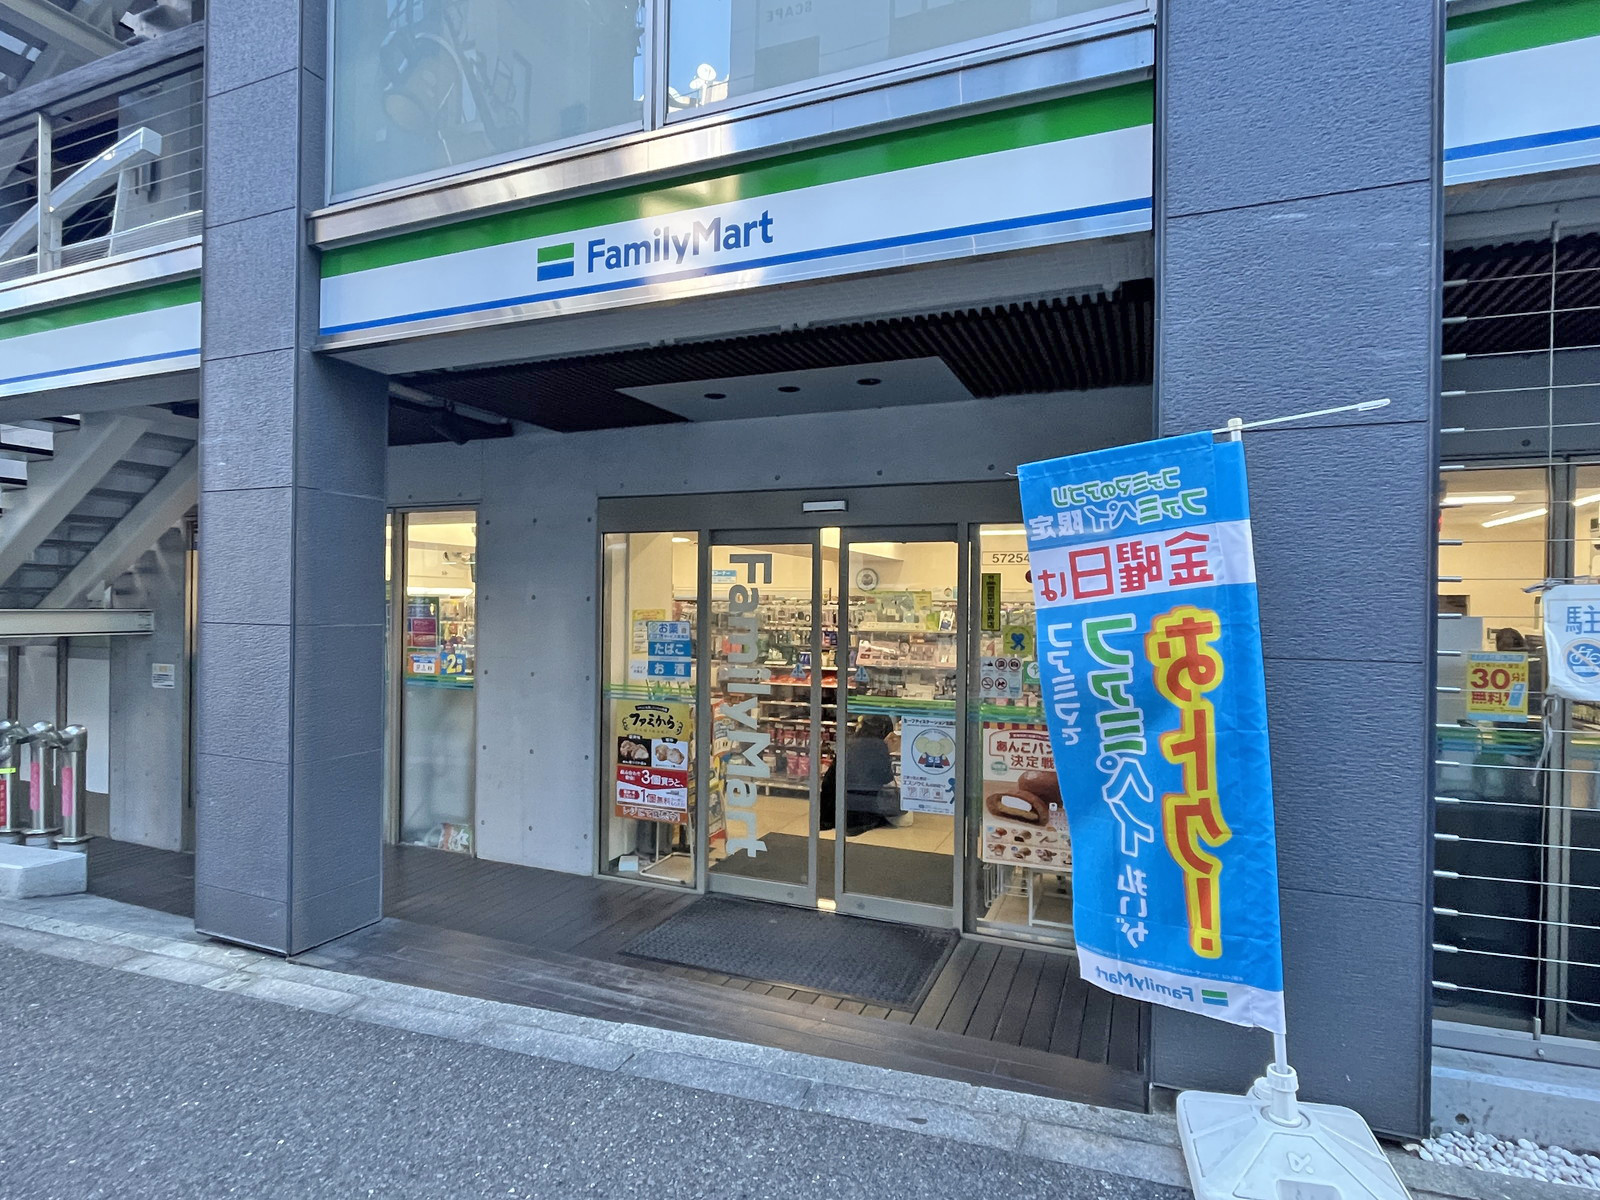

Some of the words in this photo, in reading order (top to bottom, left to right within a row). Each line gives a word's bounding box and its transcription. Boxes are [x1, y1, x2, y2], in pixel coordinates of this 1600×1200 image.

[587, 209, 774, 273] FamilyMart
[654, 642, 685, 655] たばこ
[720, 553, 773, 858] FamilyMart
[629, 712, 676, 730] ファミから
[996, 740, 1053, 755] あんこパン
[1010, 754, 1055, 770] 決定戦
